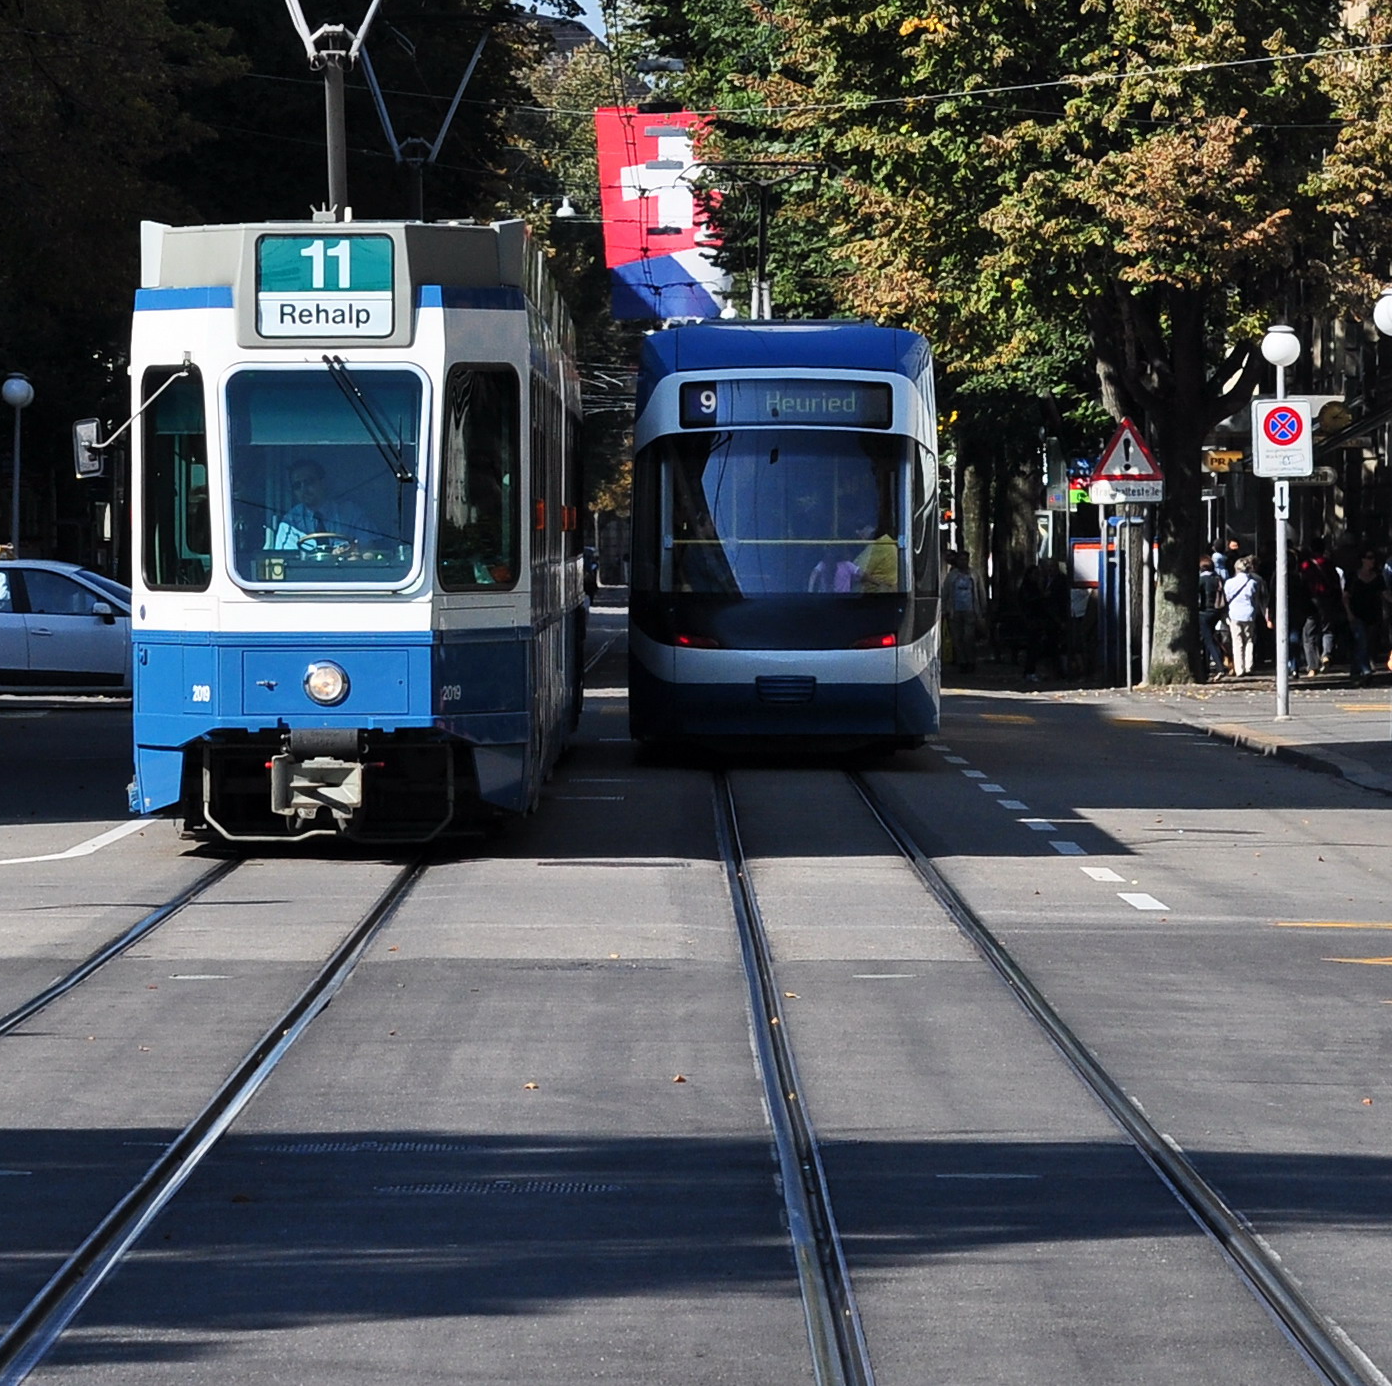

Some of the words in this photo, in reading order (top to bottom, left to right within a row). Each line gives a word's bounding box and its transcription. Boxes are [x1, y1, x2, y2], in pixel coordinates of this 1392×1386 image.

[300, 239, 351, 289] 11
[279, 303, 371, 329] Rehalp
[700, 390, 716, 414] 9
[765, 390, 856, 413] Heuried
[192, 684, 211, 702] 2019
[442, 684, 462, 701] 2019
